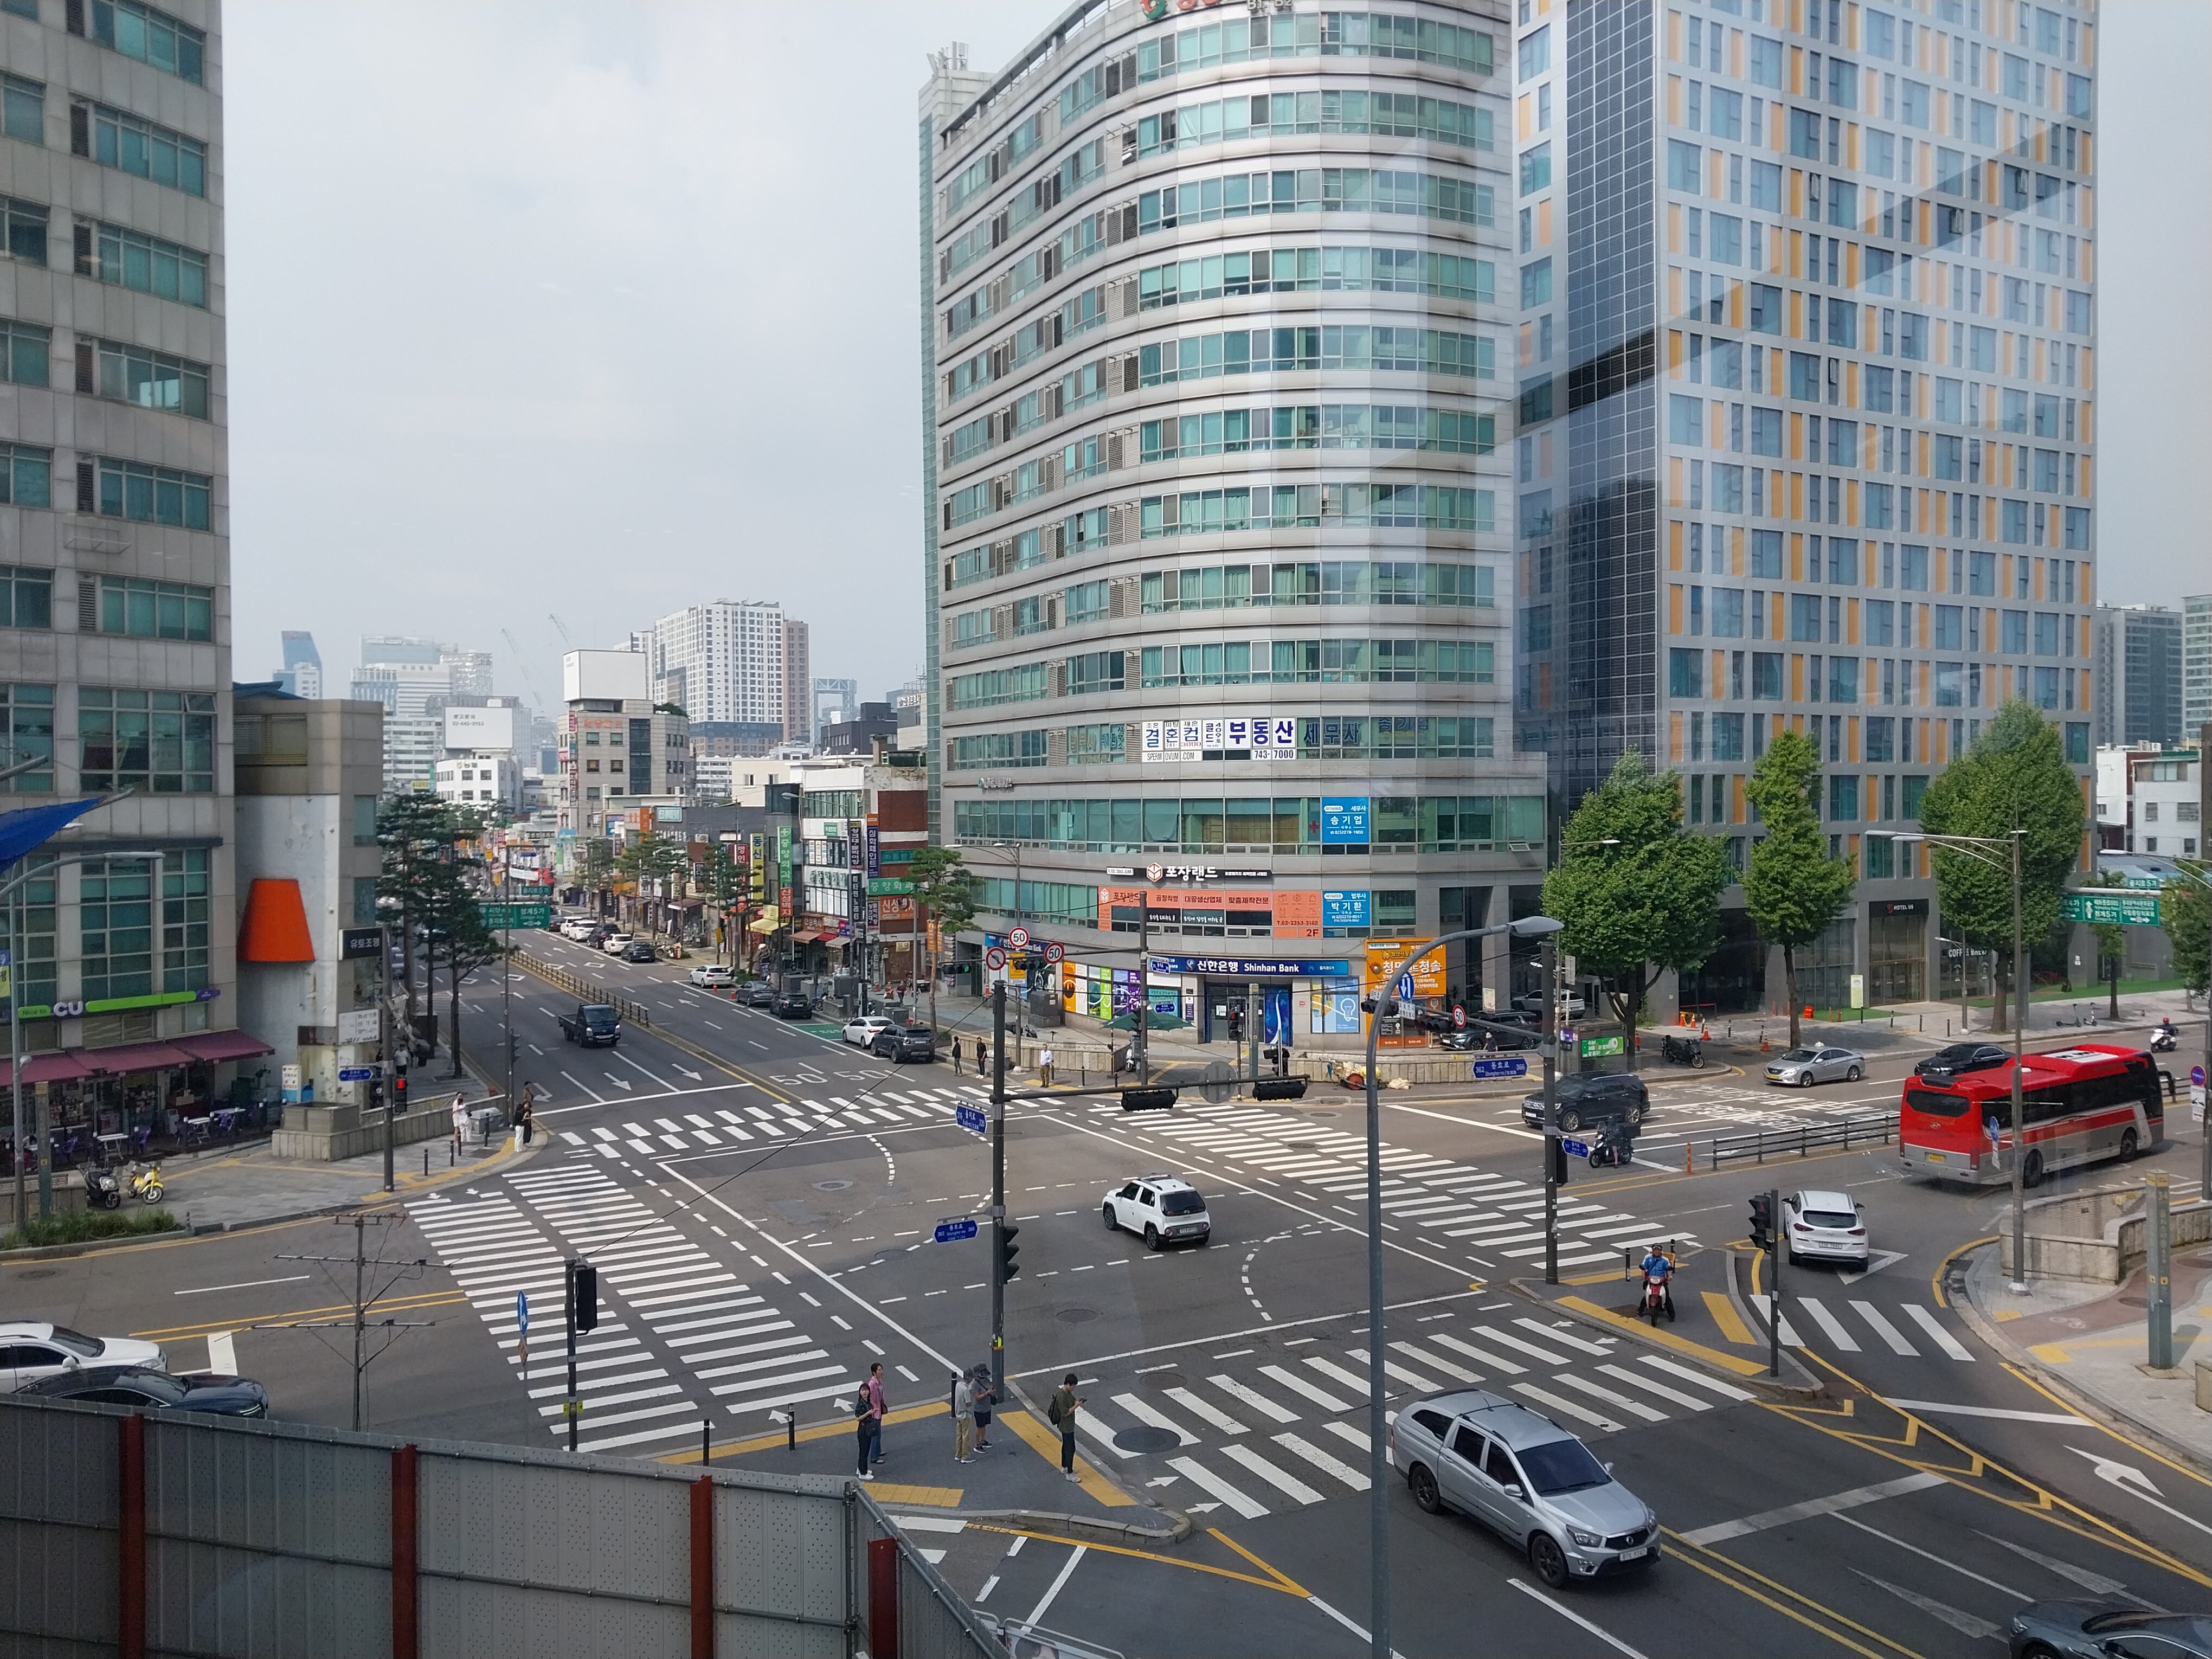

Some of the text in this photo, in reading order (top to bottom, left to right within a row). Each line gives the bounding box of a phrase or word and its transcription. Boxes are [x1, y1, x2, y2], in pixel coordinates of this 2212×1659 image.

[1230, 721, 1294, 744] 부동산
[1303, 722, 1359, 745] 세무사
[1165, 752, 1179, 760] OVUM
[1330, 815, 1362, 825] 송기업
[753, 836, 762, 859] 동신
[1166, 865, 1218, 881] 포장랜드
[1331, 902, 1362, 911] 박기환
[1013, 933, 1025, 942] 50
[1306, 929, 1319, 937] 2F
[350, 937, 380, 948] 유토조명
[1048, 948, 1060, 959] 50
[1197, 960, 1300, 972] 신한은행 Shinhan Bank
[53, 1001, 83, 1017] CU
[1455, 1011, 1463, 1022] 50
[1491, 1061, 1510, 1070] 동호로
[769, 1073, 828, 1085] 50
[833, 1070, 892, 1081] 50
[965, 1109, 976, 1120] 을지로
